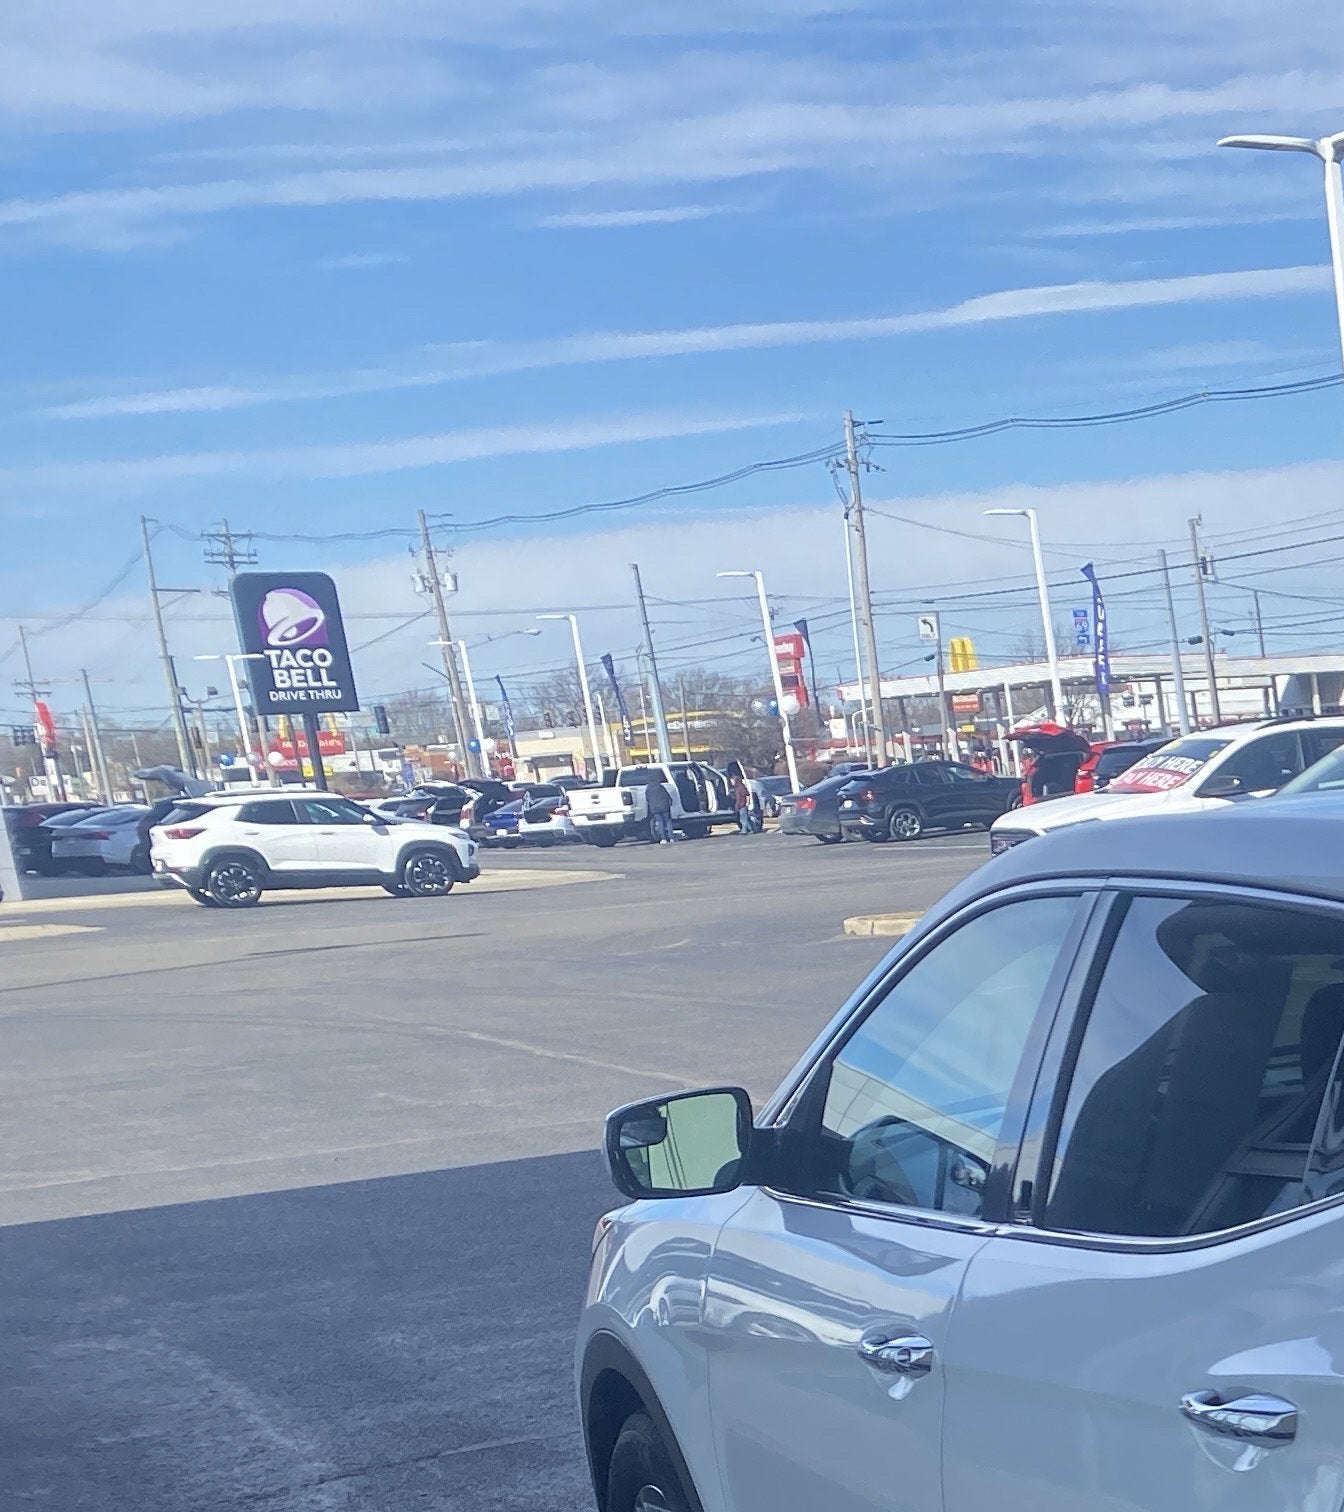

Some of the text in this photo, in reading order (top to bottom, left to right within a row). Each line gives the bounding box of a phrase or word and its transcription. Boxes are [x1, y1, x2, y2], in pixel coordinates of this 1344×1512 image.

[263, 648, 333, 669] TACO
[272, 668, 337, 689] BELL
[269, 689, 342, 701] DRIVE THRU
